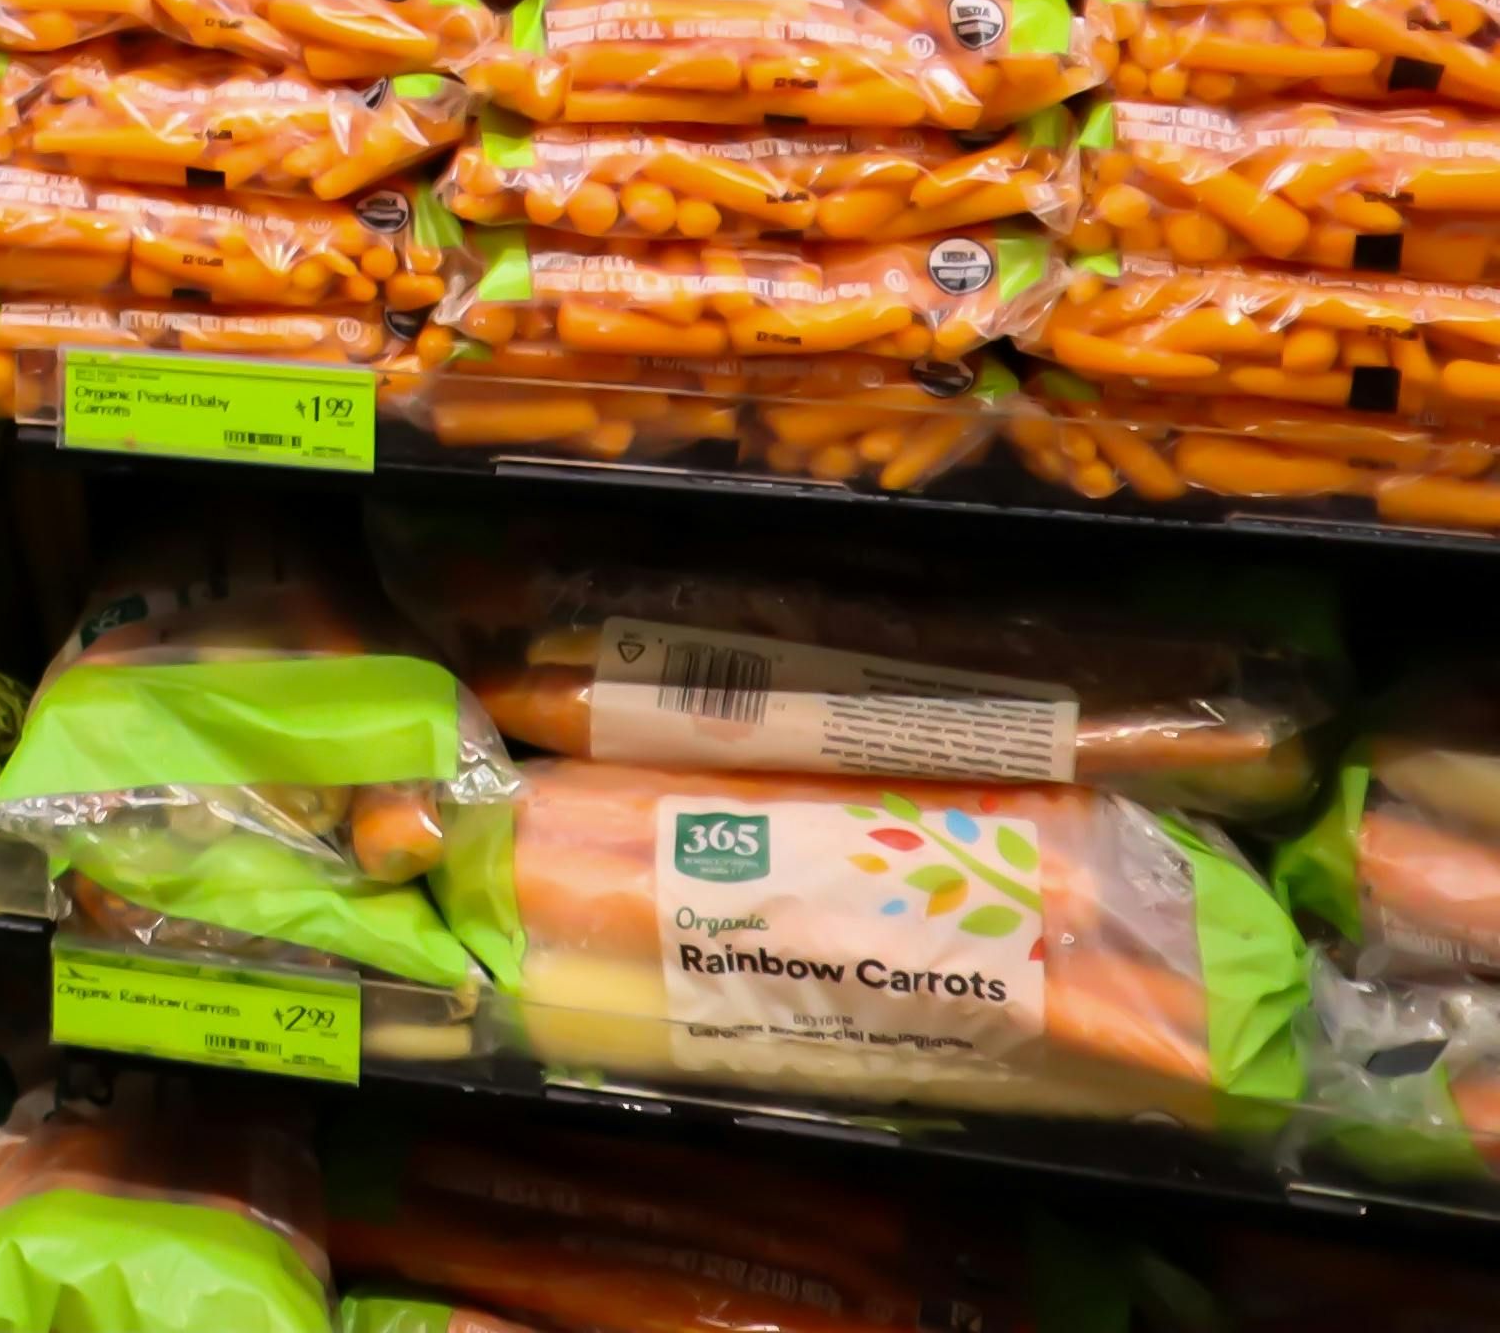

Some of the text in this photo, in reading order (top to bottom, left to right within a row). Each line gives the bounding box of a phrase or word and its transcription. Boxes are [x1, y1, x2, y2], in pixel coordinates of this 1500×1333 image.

[74, 384, 230, 413] Organic Peeled Baby
[74, 401, 132, 418] Carrots
[683, 820, 760, 856] 365
[675, 906, 770, 938] Organic
[679, 944, 1008, 1003] Rainbow Carrots
[56, 983, 241, 1017] Organic Rainbow Carrots
